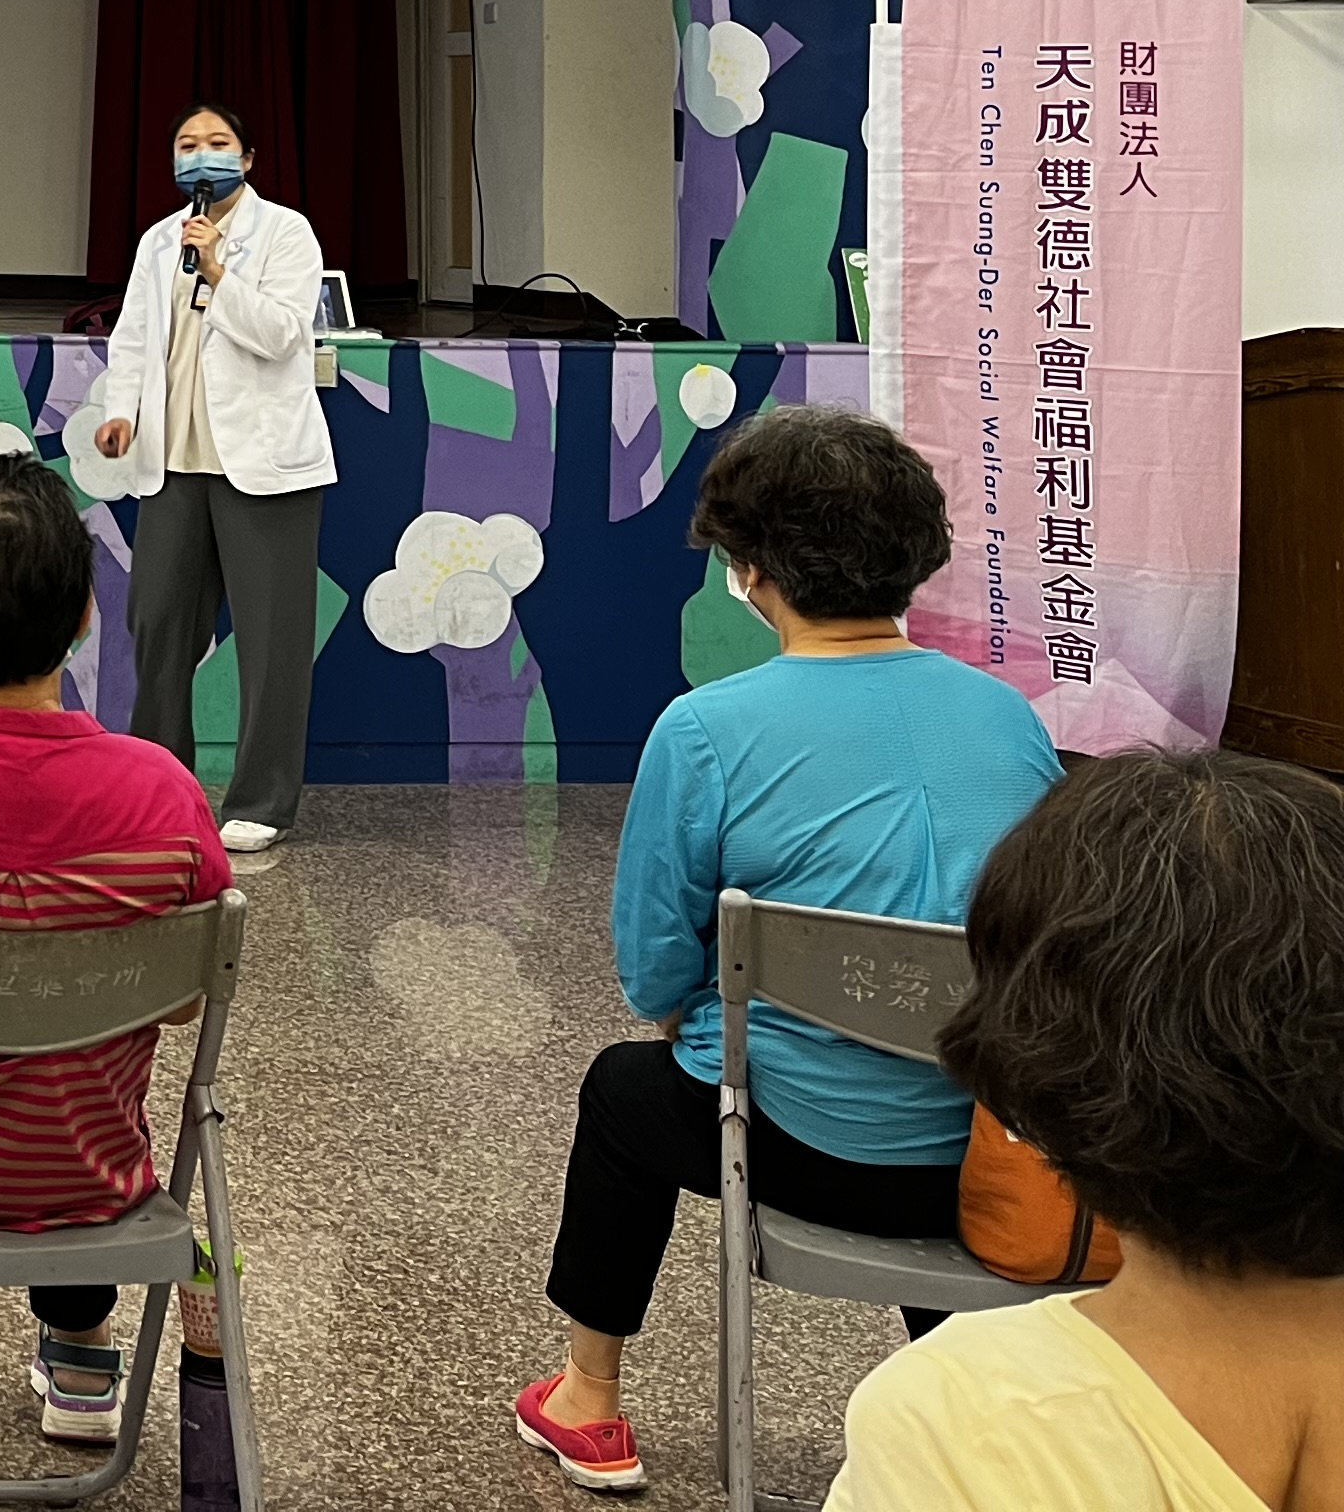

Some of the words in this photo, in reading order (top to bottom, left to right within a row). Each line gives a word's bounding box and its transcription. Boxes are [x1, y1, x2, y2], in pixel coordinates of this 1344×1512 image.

[981, 45, 1002, 90] Ten
[1119, 40, 1160, 199] 財團法人
[980, 104, 1002, 167] Chen
[973, 181, 1000, 313] Suang-Der
[978, 327, 1000, 402] Social
[1033, 43, 1097, 686] 天成雙德社會福利基金會
[981, 416, 1003, 516] Welfare
[986, 528, 1011, 665] Foundation
